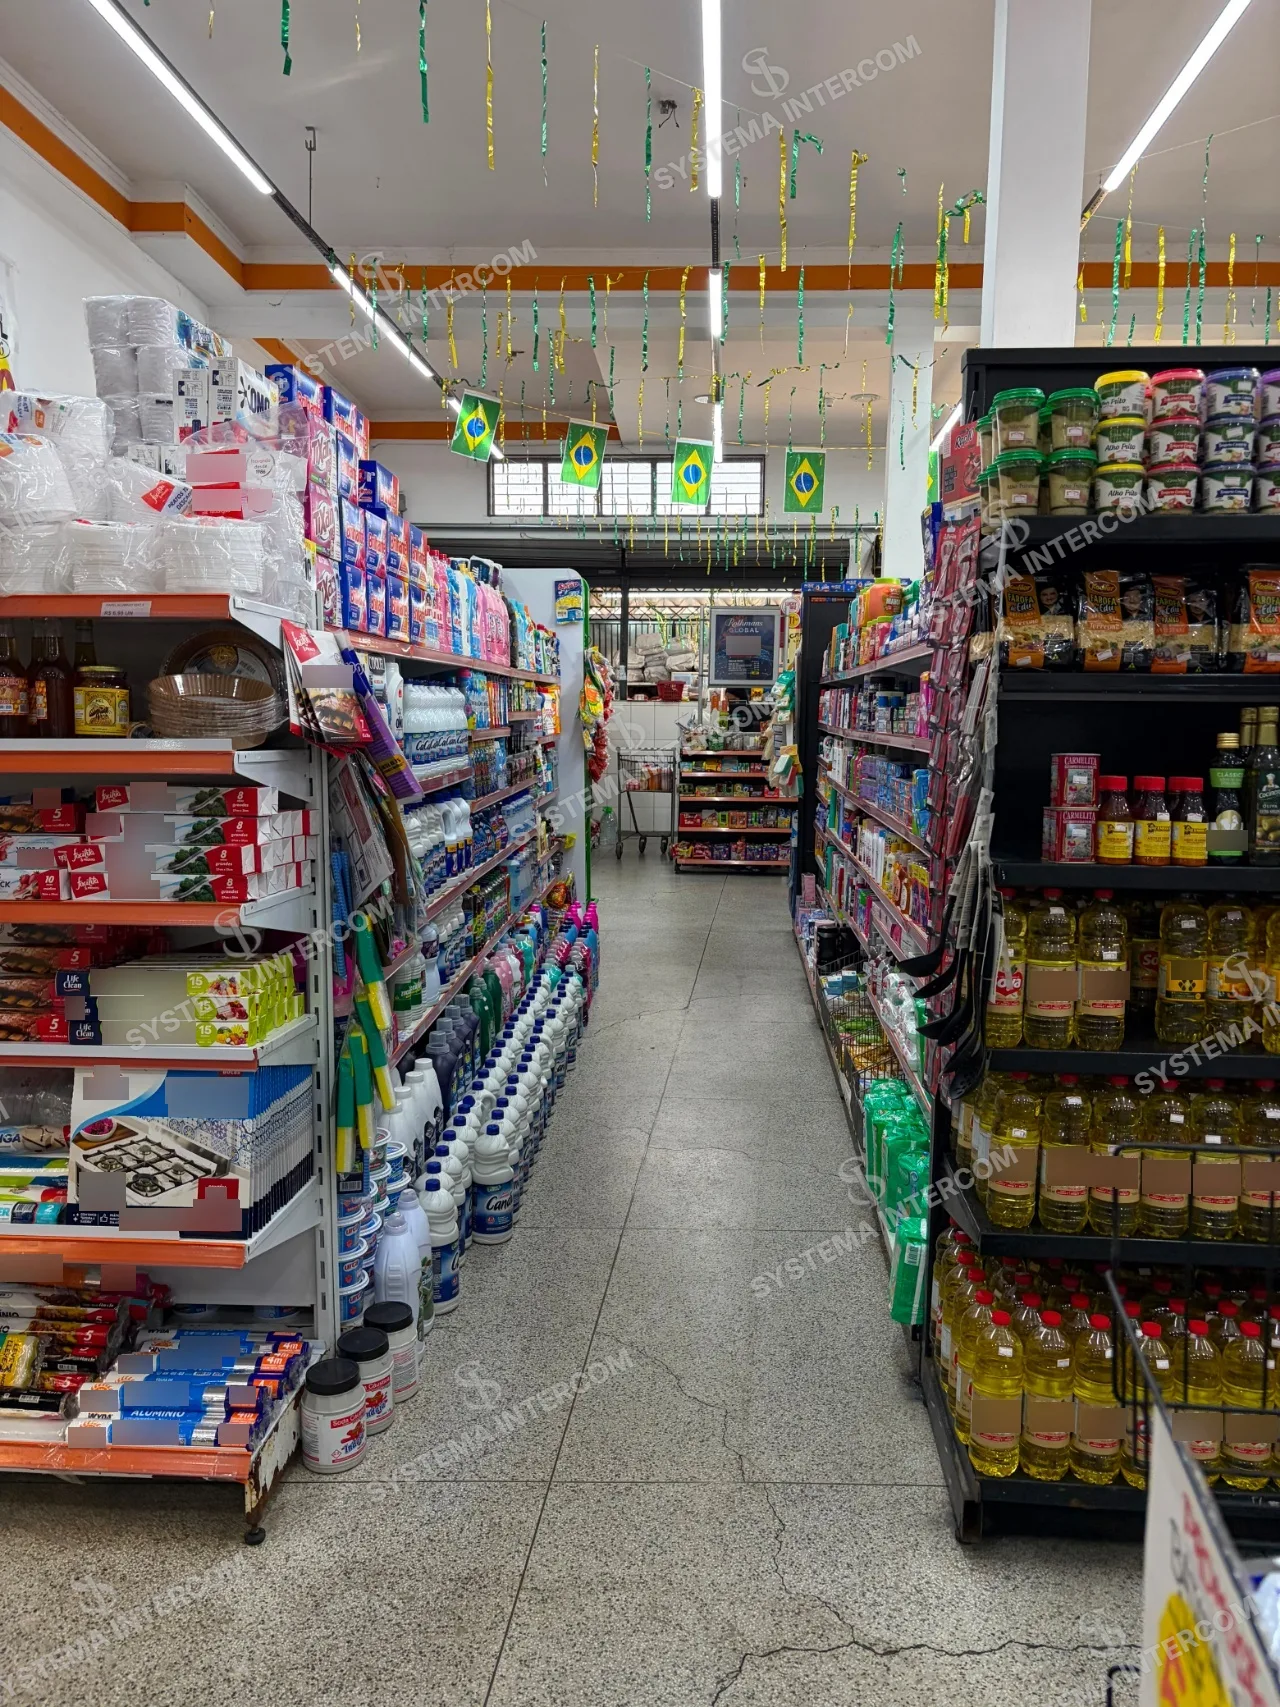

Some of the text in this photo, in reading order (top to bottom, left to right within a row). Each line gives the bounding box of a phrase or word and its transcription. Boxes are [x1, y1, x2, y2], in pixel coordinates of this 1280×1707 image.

[176, 492, 192, 510] DESCA
[1008, 595, 1034, 606] FAROFA
[1090, 594, 1116, 604] FAROFA
[1064, 758, 1097, 766] CARMELITA
[237, 791, 244, 800] 8
[53, 808, 62, 819] 5
[1062, 812, 1096, 820] CARMELITA
[236, 821, 244, 830] 8
[220, 850, 227, 859] 8
[44, 876, 54, 884] 10
[226, 878, 234, 887] 8
[70, 950, 80, 962] 5
[66, 974, 80, 983] Life
[189, 976, 202, 986] 15
[63, 981, 82, 990] Clean
[198, 1000, 212, 1012] 15
[50, 1018, 58, 1030] 5
[79, 1023, 92, 1032] Life
[76, 1029, 95, 1038] Clean
[198, 1024, 212, 1034] 15
[486, 1194, 512, 1211] Cand
[44, 1204, 54, 1213] 2
[84, 1330, 94, 1342] 5
[282, 1342, 298, 1350] 4m
[266, 1356, 283, 1364] 4m
[62, 1376, 70, 1388] 5
[332, 1416, 348, 1426] Soda
